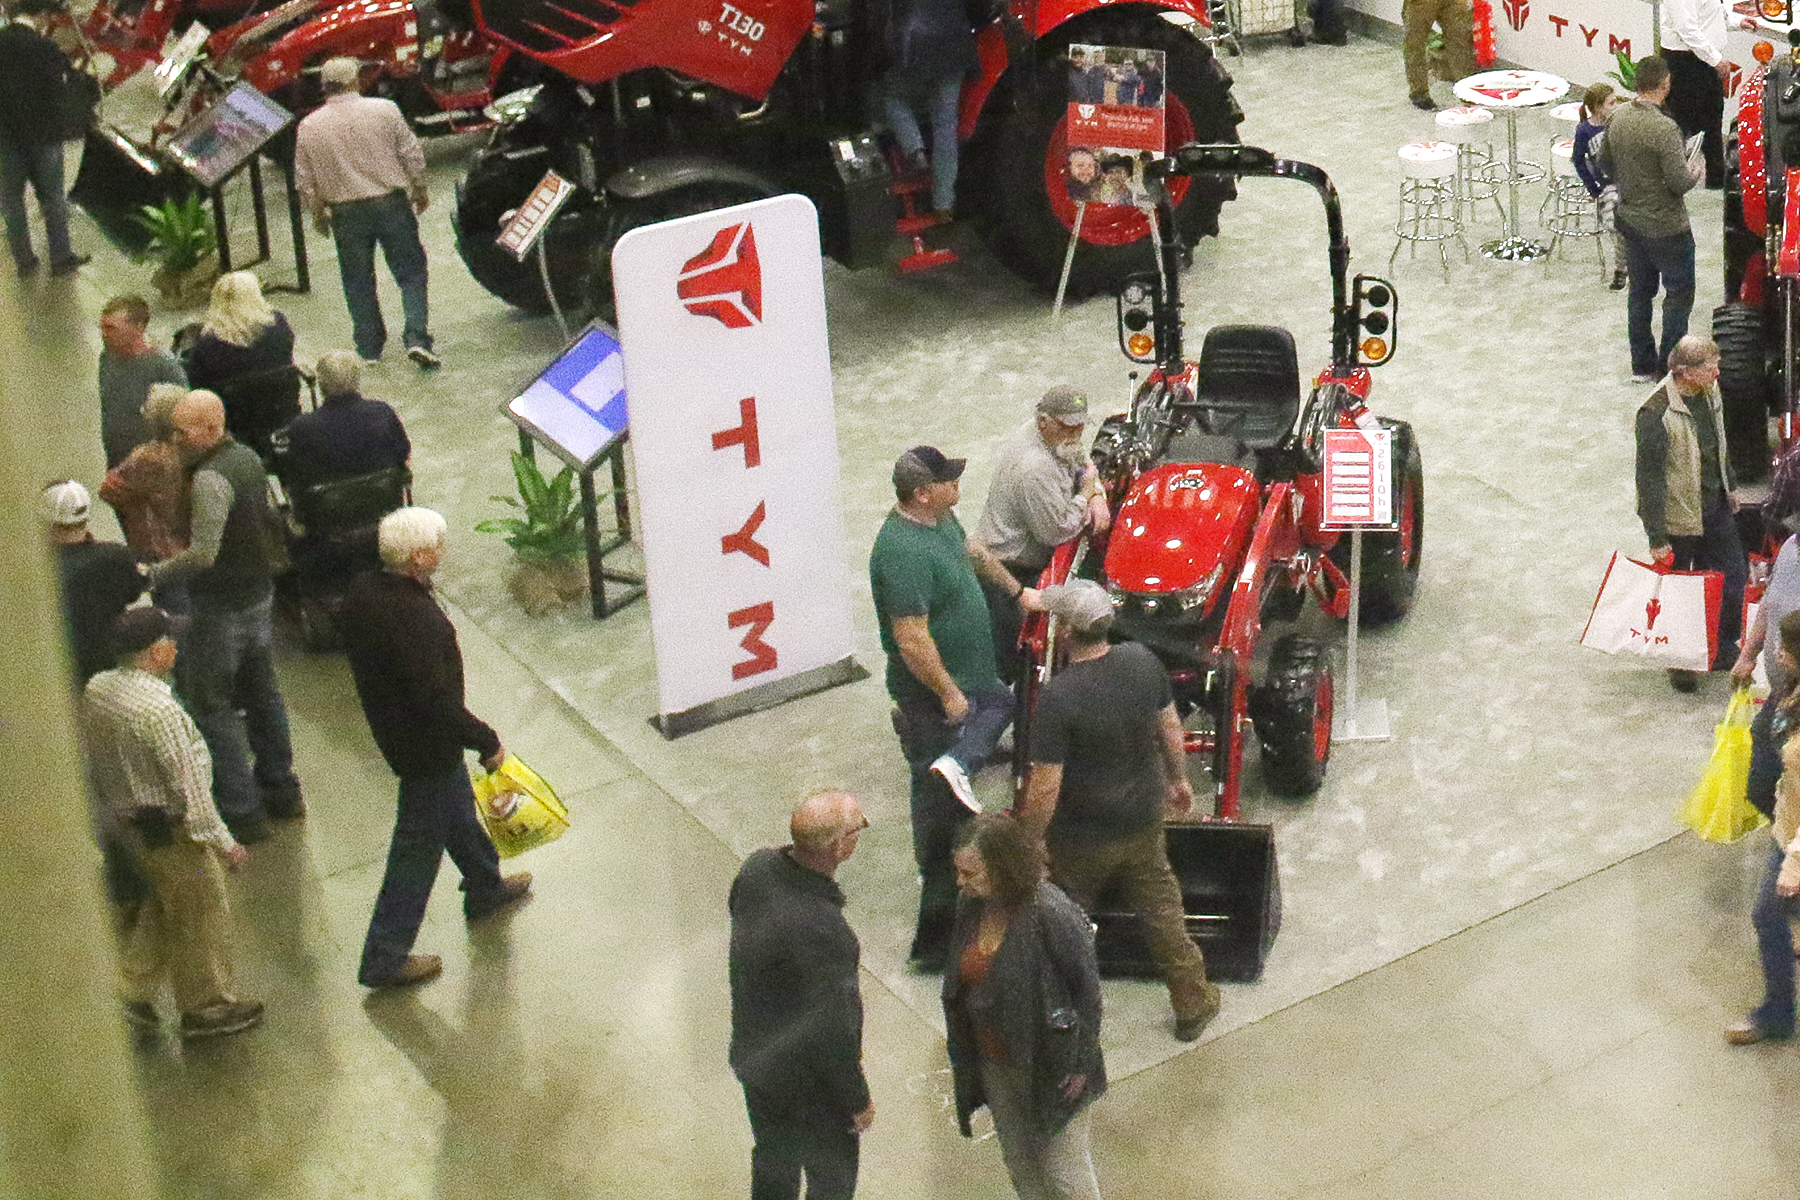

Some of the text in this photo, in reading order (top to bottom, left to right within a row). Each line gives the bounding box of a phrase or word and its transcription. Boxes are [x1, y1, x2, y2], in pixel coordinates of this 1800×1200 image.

[717, 2, 766, 42] T130
[1548, 15, 1631, 59] TYM
[715, 32, 753, 57] TYM
[712, 397, 778, 680] TYM
[1628, 625, 1671, 647] TYM
